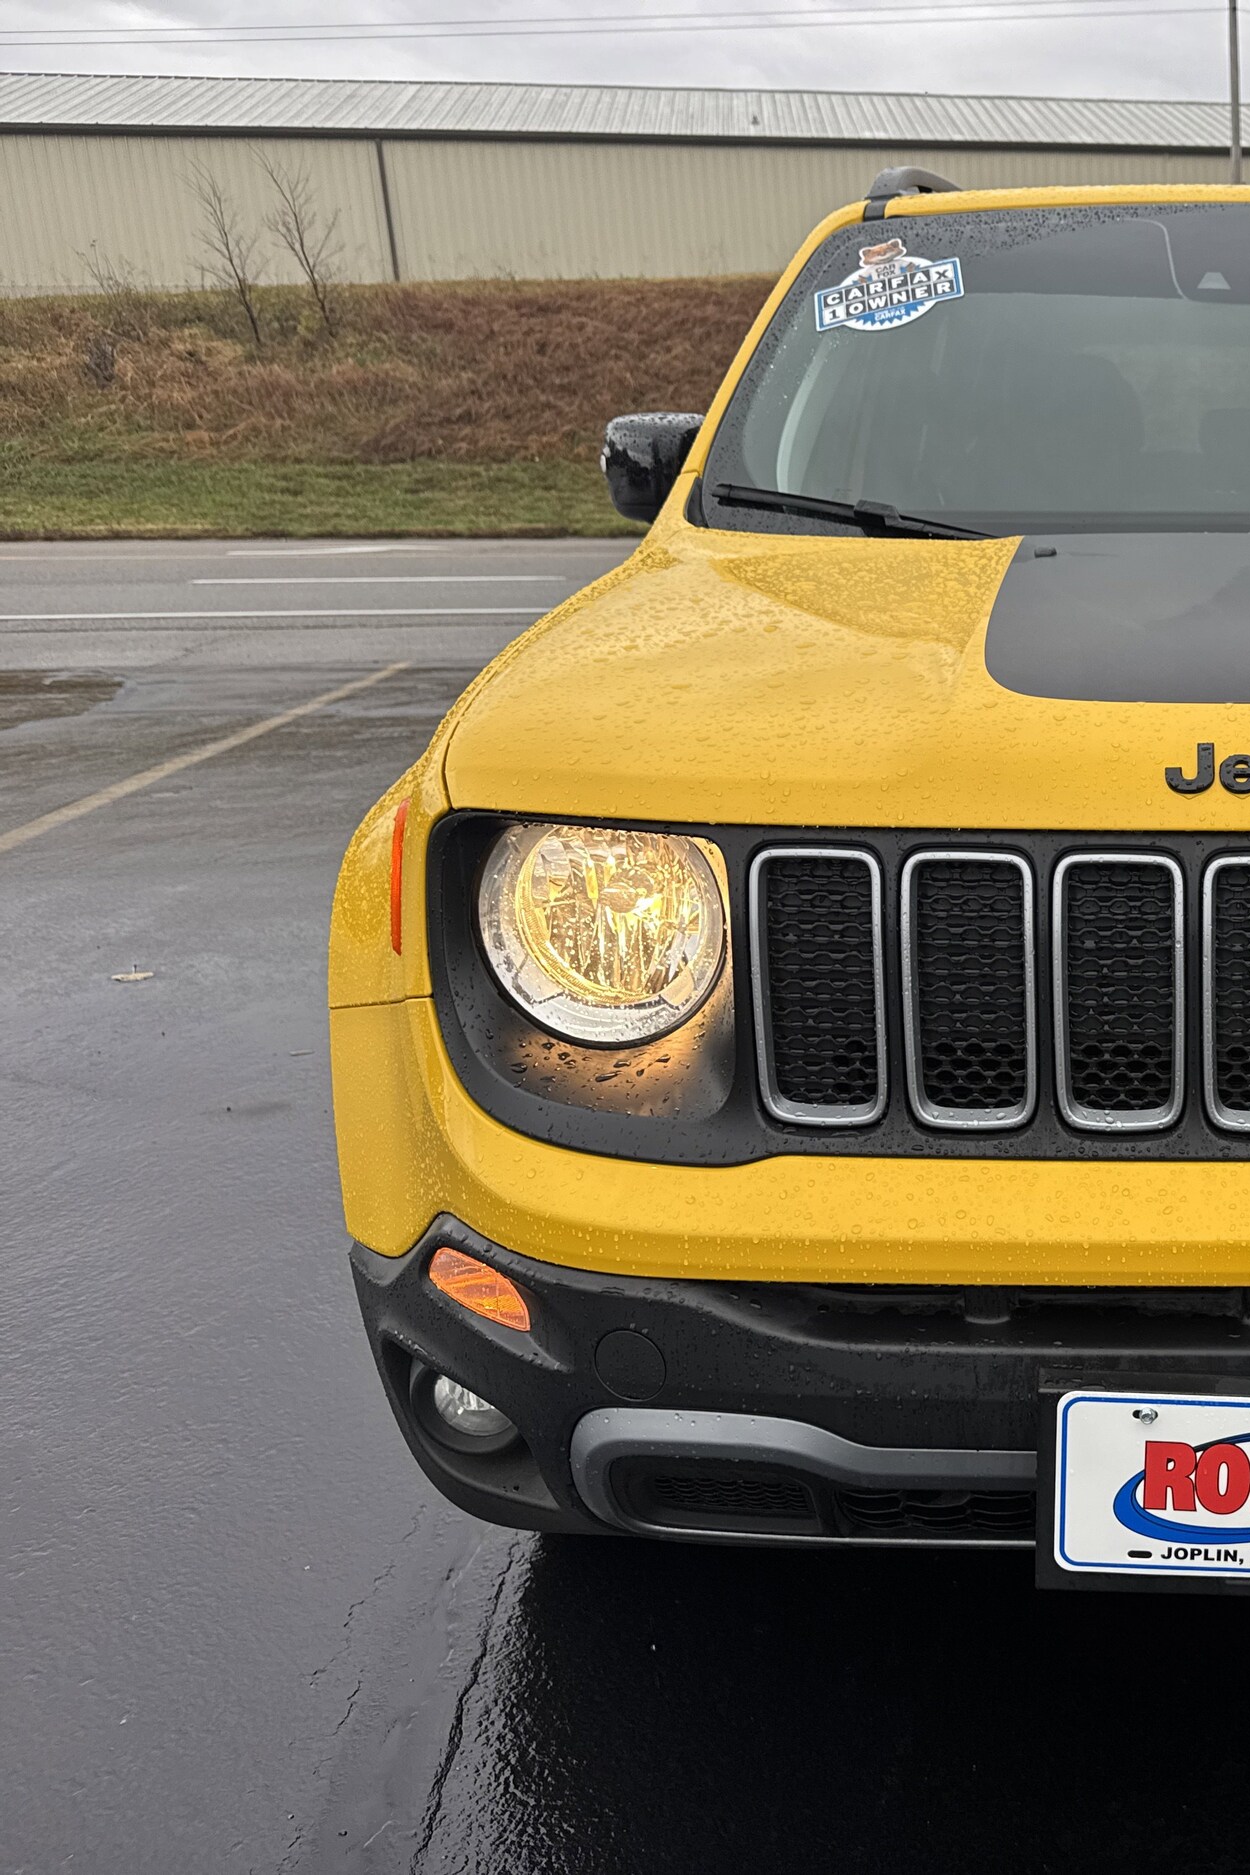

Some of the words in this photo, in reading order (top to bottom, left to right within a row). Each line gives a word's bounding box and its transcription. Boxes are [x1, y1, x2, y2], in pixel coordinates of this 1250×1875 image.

[875, 263, 896, 274] CAR
[877, 269, 896, 279] FOX
[826, 269, 949, 305] CARFAX
[874, 309, 906, 321] CARFAX
[1161, 1547, 1244, 1565] JOPLIN,
